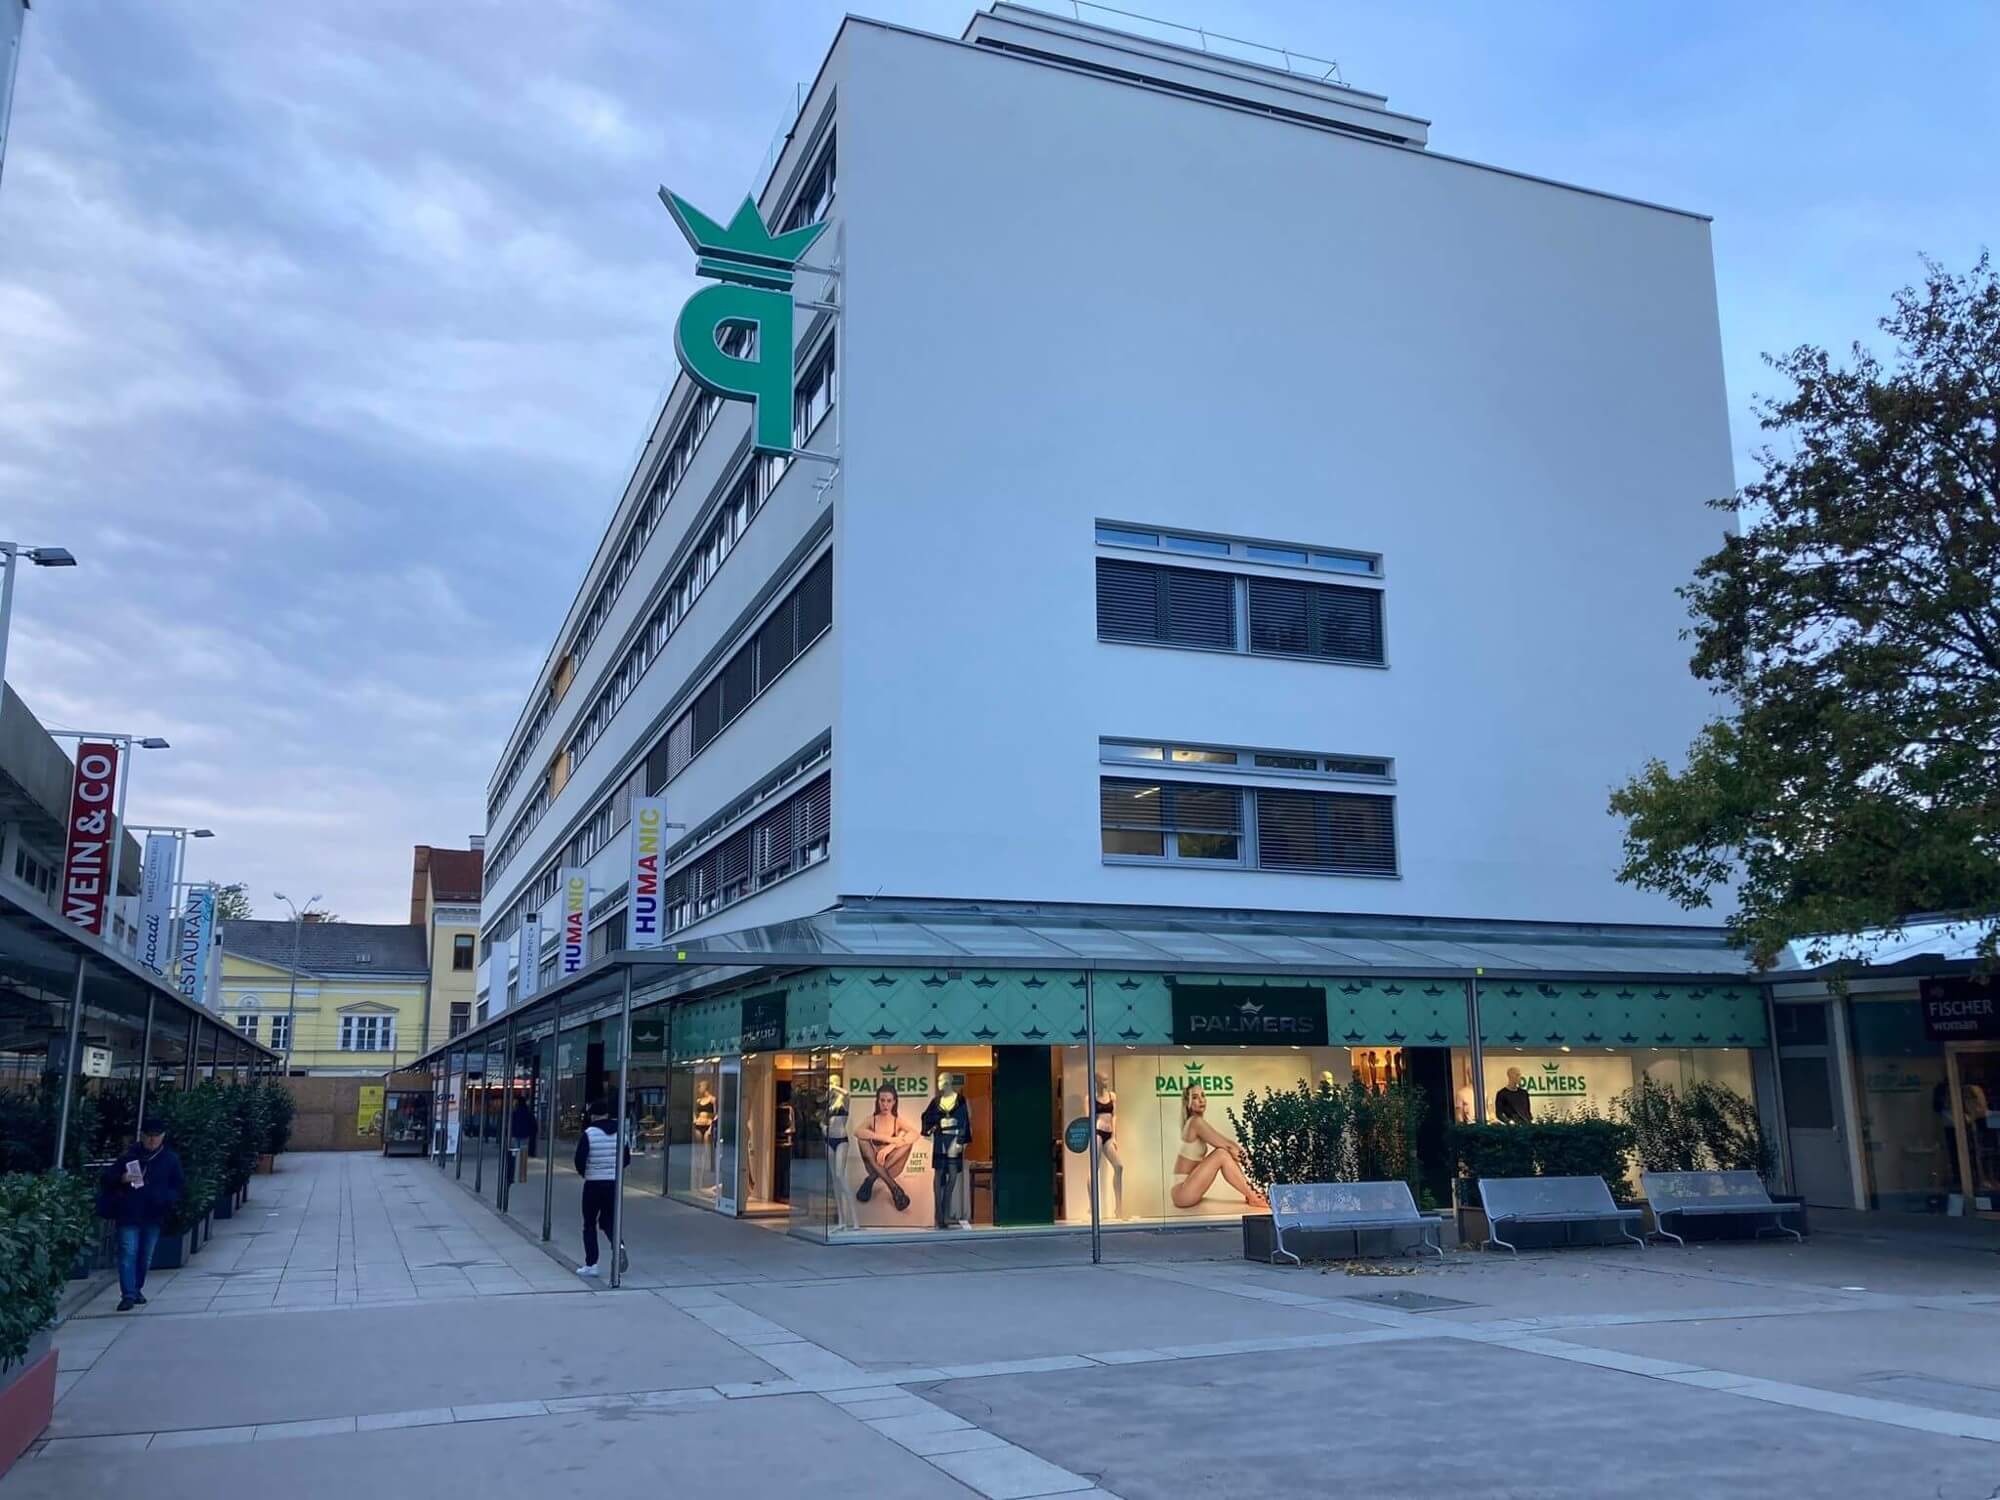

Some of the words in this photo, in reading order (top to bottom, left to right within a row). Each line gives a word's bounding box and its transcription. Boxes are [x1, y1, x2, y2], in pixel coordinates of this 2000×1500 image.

[78, 754, 112, 803] CO
[76, 808, 106, 835] &
[65, 841, 103, 927] WEIN
[636, 808, 660, 934] HUMANIC
[178, 889, 203, 995] ESTAURANT
[565, 877, 585, 973] HUMANIC
[1190, 1015, 1316, 1033] PALMERS
[1929, 999, 1995, 1017] FISCHER
